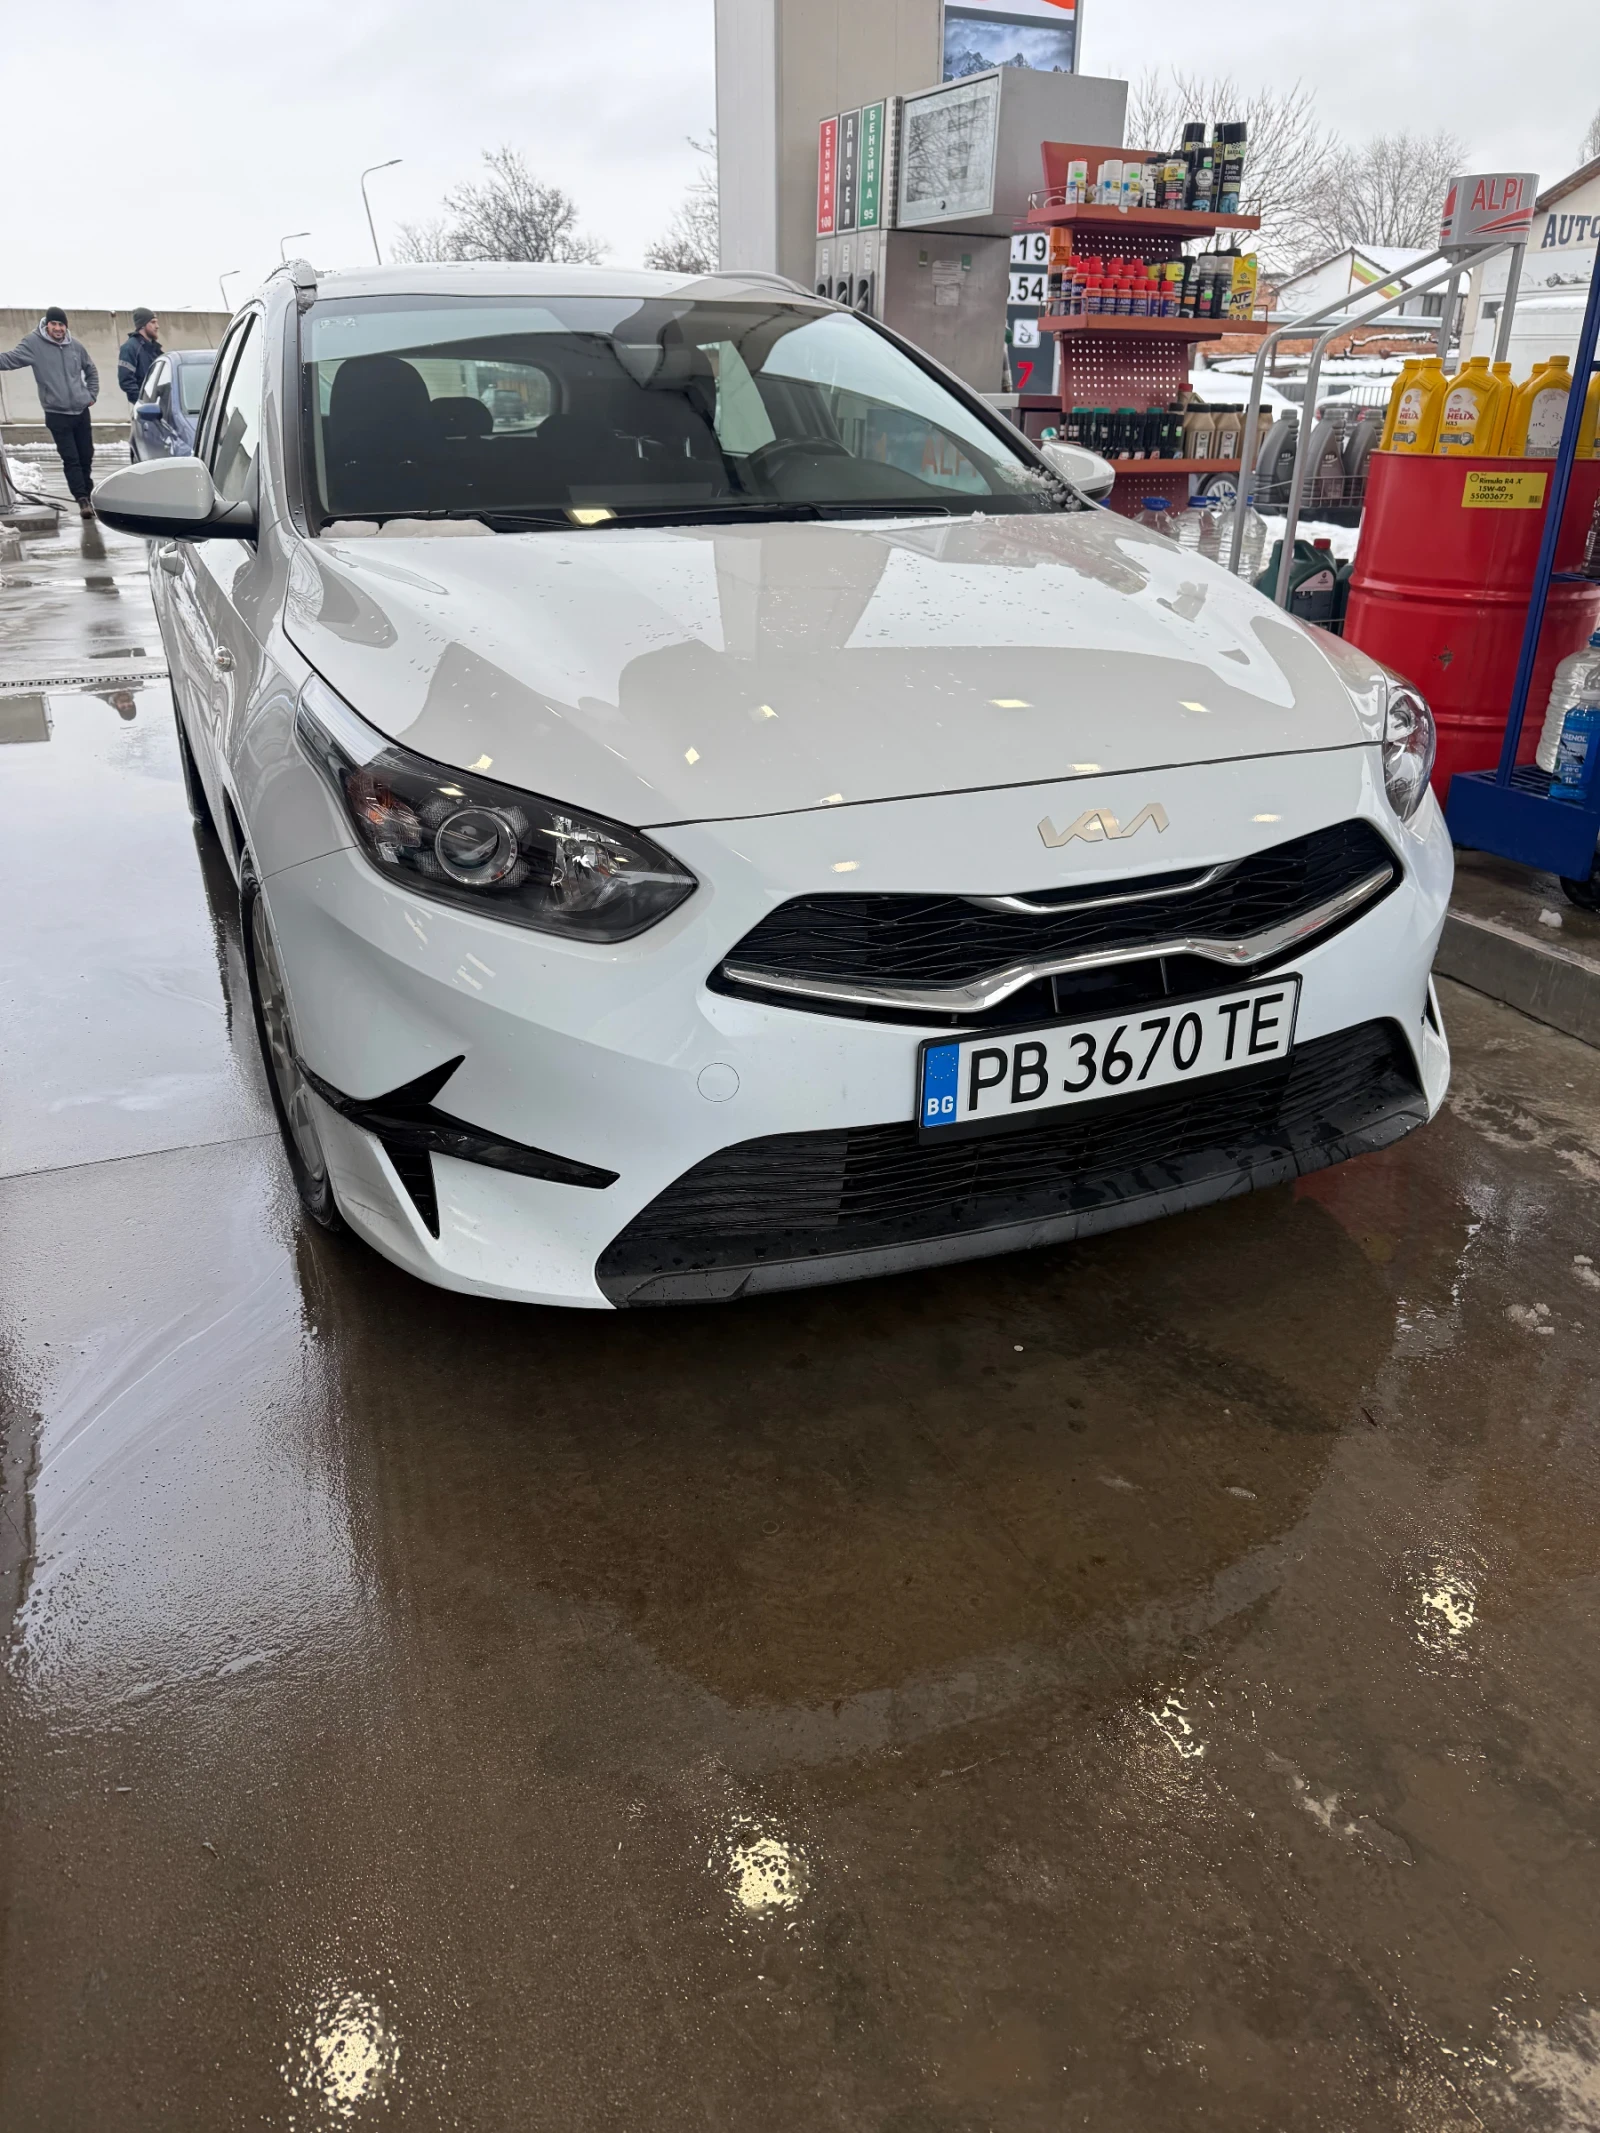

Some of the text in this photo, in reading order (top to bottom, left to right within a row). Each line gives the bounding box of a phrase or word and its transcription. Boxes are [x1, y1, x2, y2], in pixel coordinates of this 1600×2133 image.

[843, 119, 854, 225] ДИЗЕЛ
[1470, 178, 1525, 211] ALPI
[820, 216, 832, 228] 100
[863, 209, 874, 220] 95
[1230, 291, 1252, 305] ATF
[1399, 410, 1419, 420] HELIX
[1446, 411, 1476, 420] HELIX
[1037, 802, 1170, 849] KIA
[968, 992, 1284, 1112] PB 3670 TE
[926, 1096, 954, 1116] BG
